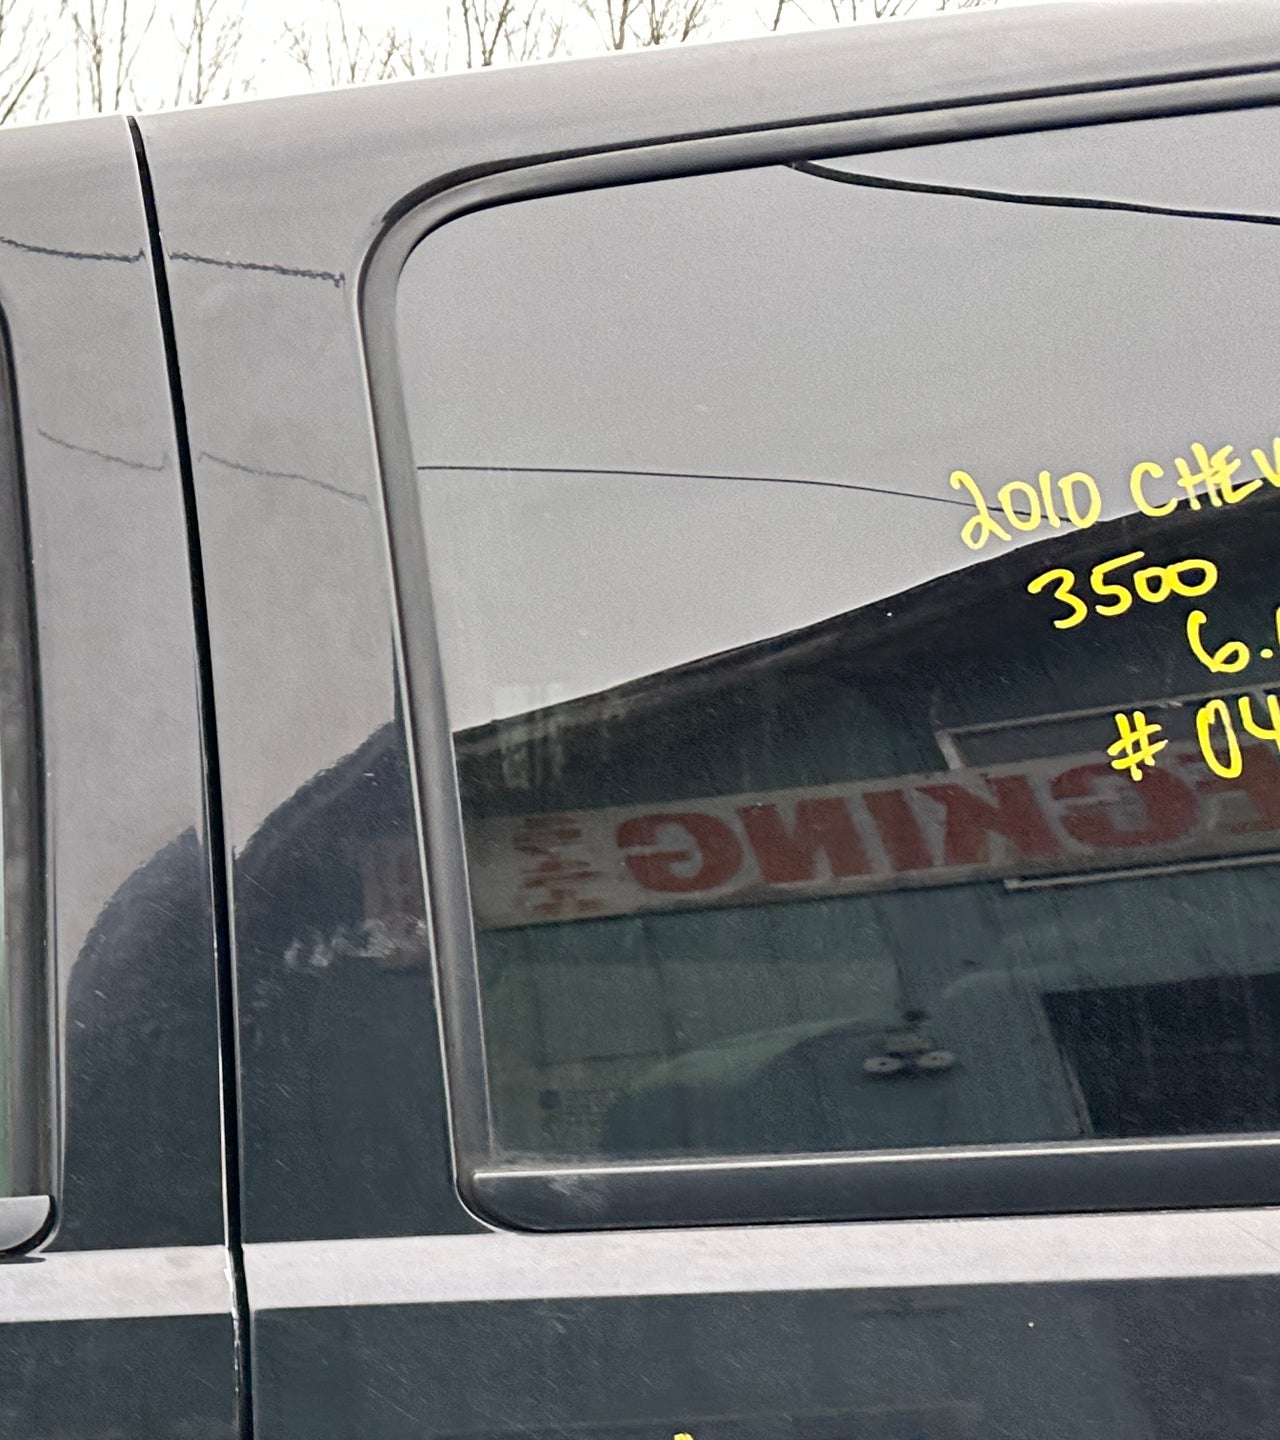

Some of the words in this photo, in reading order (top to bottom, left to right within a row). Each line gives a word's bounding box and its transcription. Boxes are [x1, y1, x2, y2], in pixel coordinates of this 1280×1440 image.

[949, 470, 1101, 549] 2010
[1027, 551, 1218, 629] 3500
[1187, 607, 1280, 672] 6.
